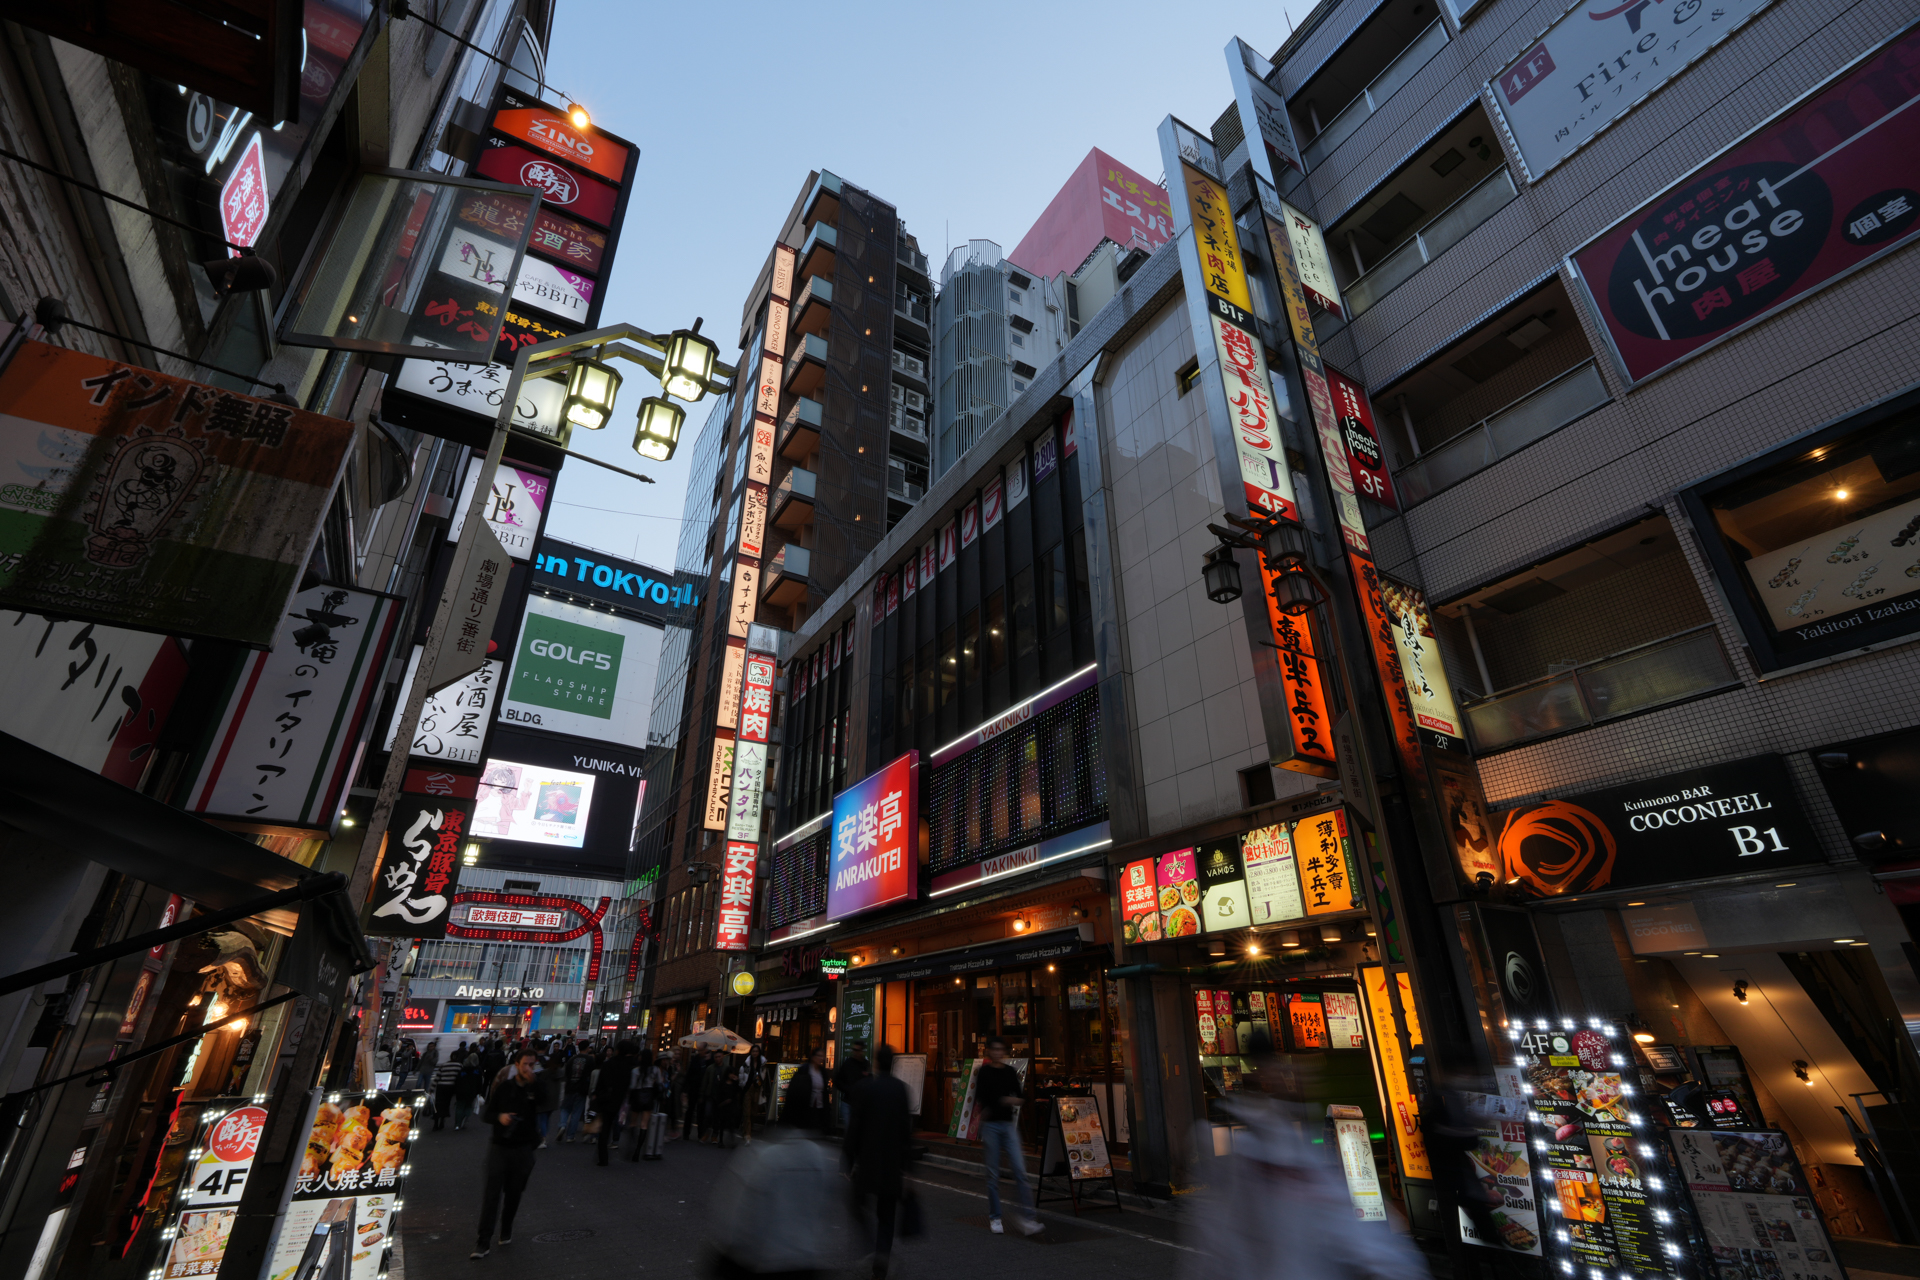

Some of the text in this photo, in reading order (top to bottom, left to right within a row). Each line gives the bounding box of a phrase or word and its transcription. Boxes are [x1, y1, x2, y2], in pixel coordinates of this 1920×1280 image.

[1505, 48, 1548, 98] 4F
[1574, 30, 1660, 104] Fire
[505, 95, 524, 108] 5F
[489, 137, 506, 148] 4F
[529, 120, 594, 156] ZINO
[1102, 185, 1175, 240] エスパ
[1662, 175, 1733, 226] 新宿個室
[1848, 195, 1914, 240] 個室
[543, 220, 583, 241] Shisha
[1631, 177, 1782, 285] meat
[1194, 195, 1230, 296] ヤマネ肉店
[570, 275, 592, 293] 2F
[1633, 208, 1805, 341] house
[1312, 292, 1330, 311] 4F
[1690, 256, 1781, 322] 肉屋
[1218, 299, 1244, 323] B1F
[770, 305, 783, 351] CASINO POKER
[81, 367, 294, 448] インド舞踊
[1345, 415, 1379, 448] meat
[1345, 429, 1379, 460] house
[754, 452, 768, 476] 魚金
[526, 478, 547, 495] 2F
[1359, 469, 1385, 499] 3F
[1258, 491, 1284, 513] 4F
[1842, 551, 1870, 564] ねぎま
[573, 556, 670, 605] TOKYO
[1785, 578, 1801, 588] もも
[457, 558, 500, 655] 劇場通り一番街
[1799, 608, 1824, 619] かわ
[1796, 613, 1864, 642] Yakitori
[529, 638, 612, 671] GOLF5
[522, 671, 608, 695] FLAGSHIP
[749, 676, 771, 685] JAPAN
[446, 659, 494, 739] 居酒屋
[553, 688, 605, 706] STORE
[506, 708, 544, 726] BLDG.
[742, 686, 771, 739] 焼肉
[981, 704, 1030, 741] YAKINIKU
[245, 637, 339, 814] 俺のイタリアン
[447, 747, 479, 761] B1F
[1434, 734, 1449, 750] 2F
[573, 755, 626, 775] YUNIKA
[1341, 734, 1363, 799] 劇場通り一番街
[708, 745, 722, 822] POKER SHINJUKU
[736, 768, 753, 820] バンタイ
[1291, 795, 1333, 813] 第1メトロビル
[1624, 785, 1713, 812] Kuimono BAR
[1629, 793, 1772, 833] COCONEEL
[838, 790, 903, 862] 安楽亭
[423, 808, 466, 894] 東京豚骨
[1244, 838, 1290, 862] 熟女キャバクラ
[1728, 824, 1790, 857] B1
[835, 846, 901, 892] ANRAKUTEI
[983, 847, 1037, 877] YAKINIKU
[718, 846, 757, 939] 安楽亭
[1126, 885, 1154, 903] 安楽亭
[470, 909, 561, 926] 歌舞伎町一番街
[1127, 900, 1155, 912] ANRAKUTEI
[717, 941, 726, 949] 2F
[1015, 944, 1073, 961] Trattoria Pizzeria Bar
[820, 959, 847, 967] Trattoria
[822, 966, 845, 974] Pizzeria
[455, 985, 544, 1000] Alpen TOKYO
[1520, 1031, 1550, 1055] 4F
[1712, 1101, 1723, 1111] 3F
[1503, 1121, 1526, 1143] 4F
[1760, 1139, 1783, 1152] 2F
[197, 1168, 248, 1196] 4F
[294, 1166, 398, 1195] 炭火焼き鳥
[1498, 1174, 1530, 1187] Sashimi
[1505, 1195, 1535, 1212] Sushi
[1632, 1198, 1646, 1206] Grill
